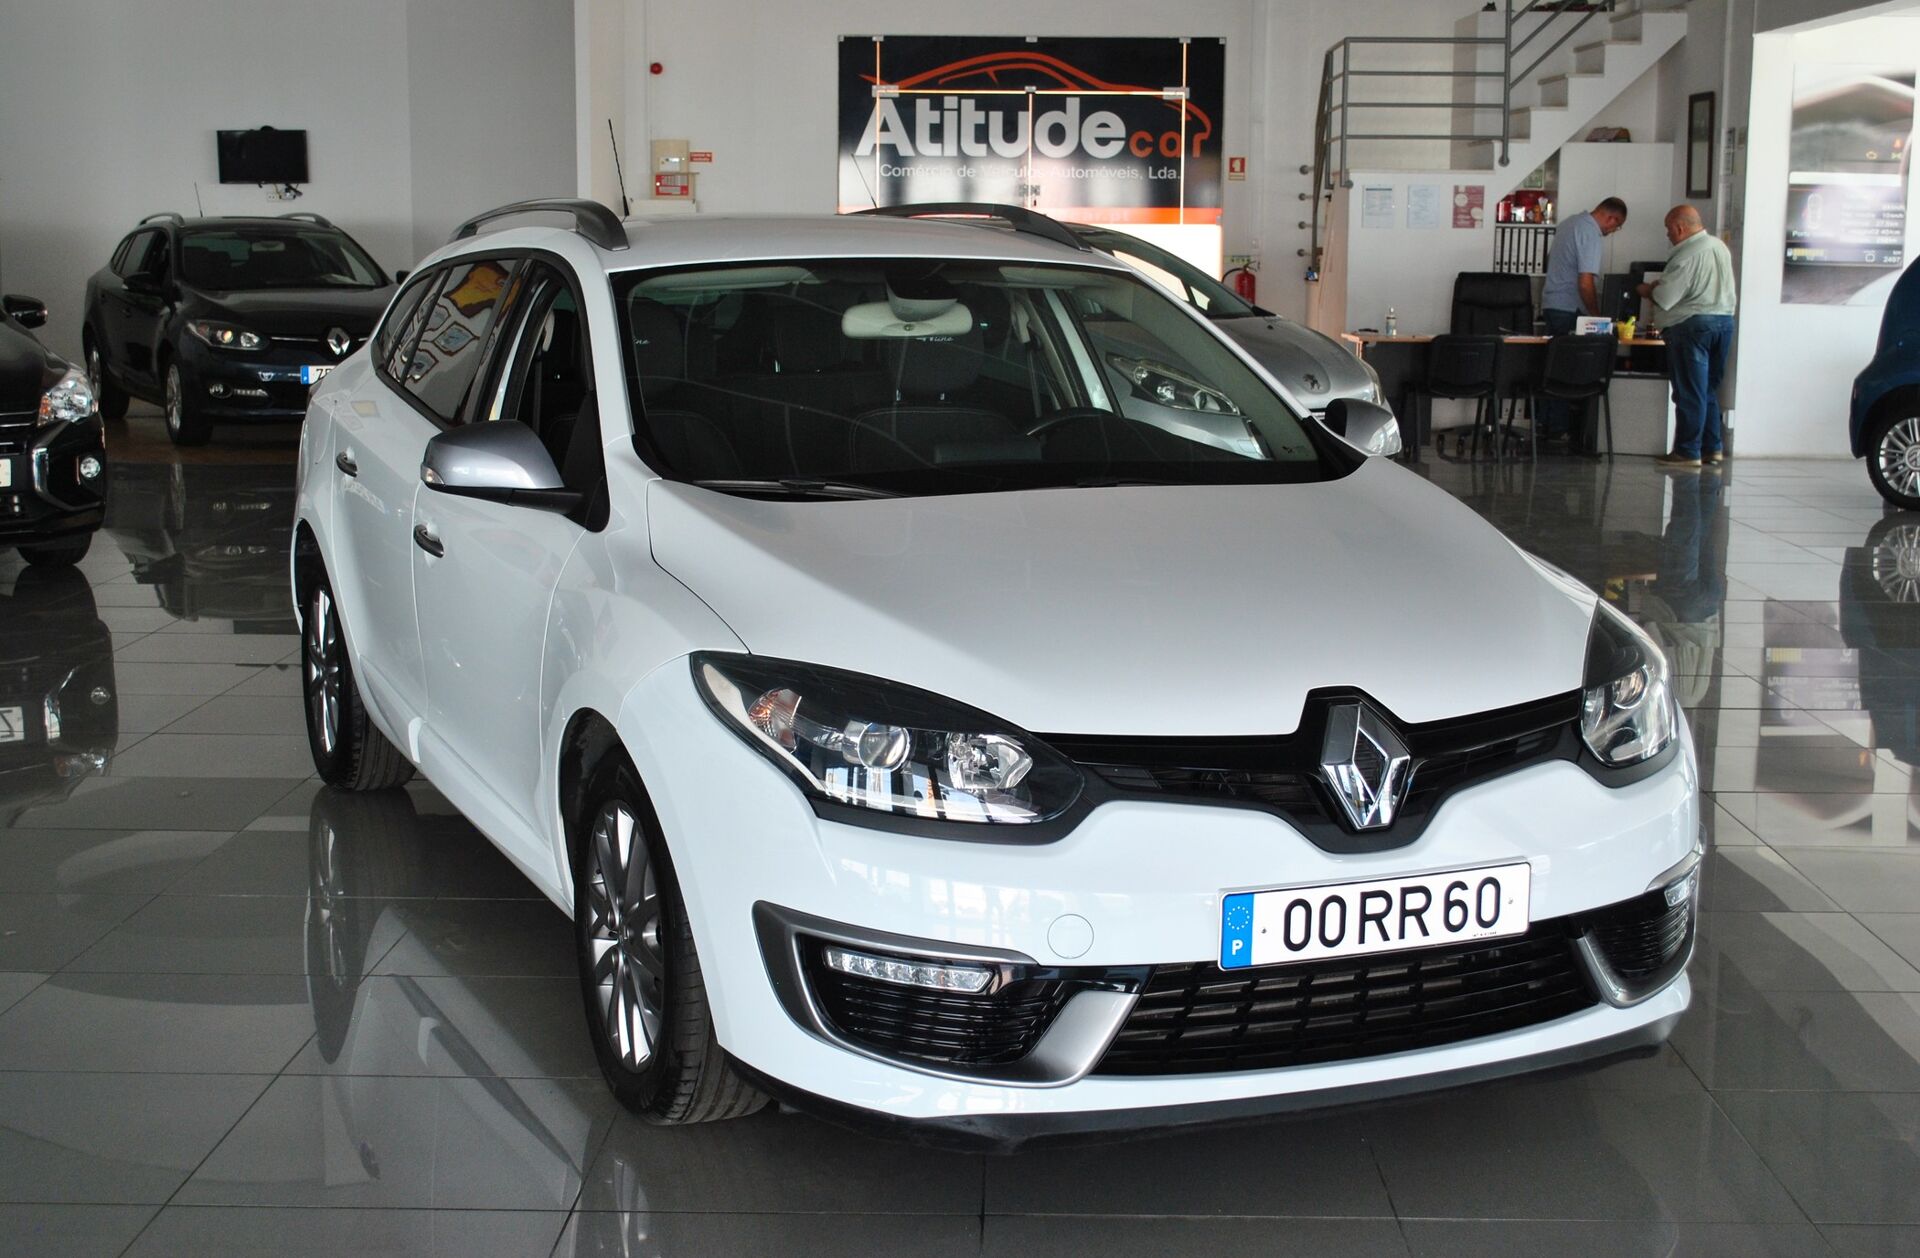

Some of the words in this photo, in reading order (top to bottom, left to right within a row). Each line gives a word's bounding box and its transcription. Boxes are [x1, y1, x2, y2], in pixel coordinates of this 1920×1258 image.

[854, 96, 1127, 159] Atitude
[1129, 130, 1207, 159] car
[957, 164, 977, 178] de
[1148, 165, 1181, 180] Lda.
[1231, 938, 1244, 956] P
